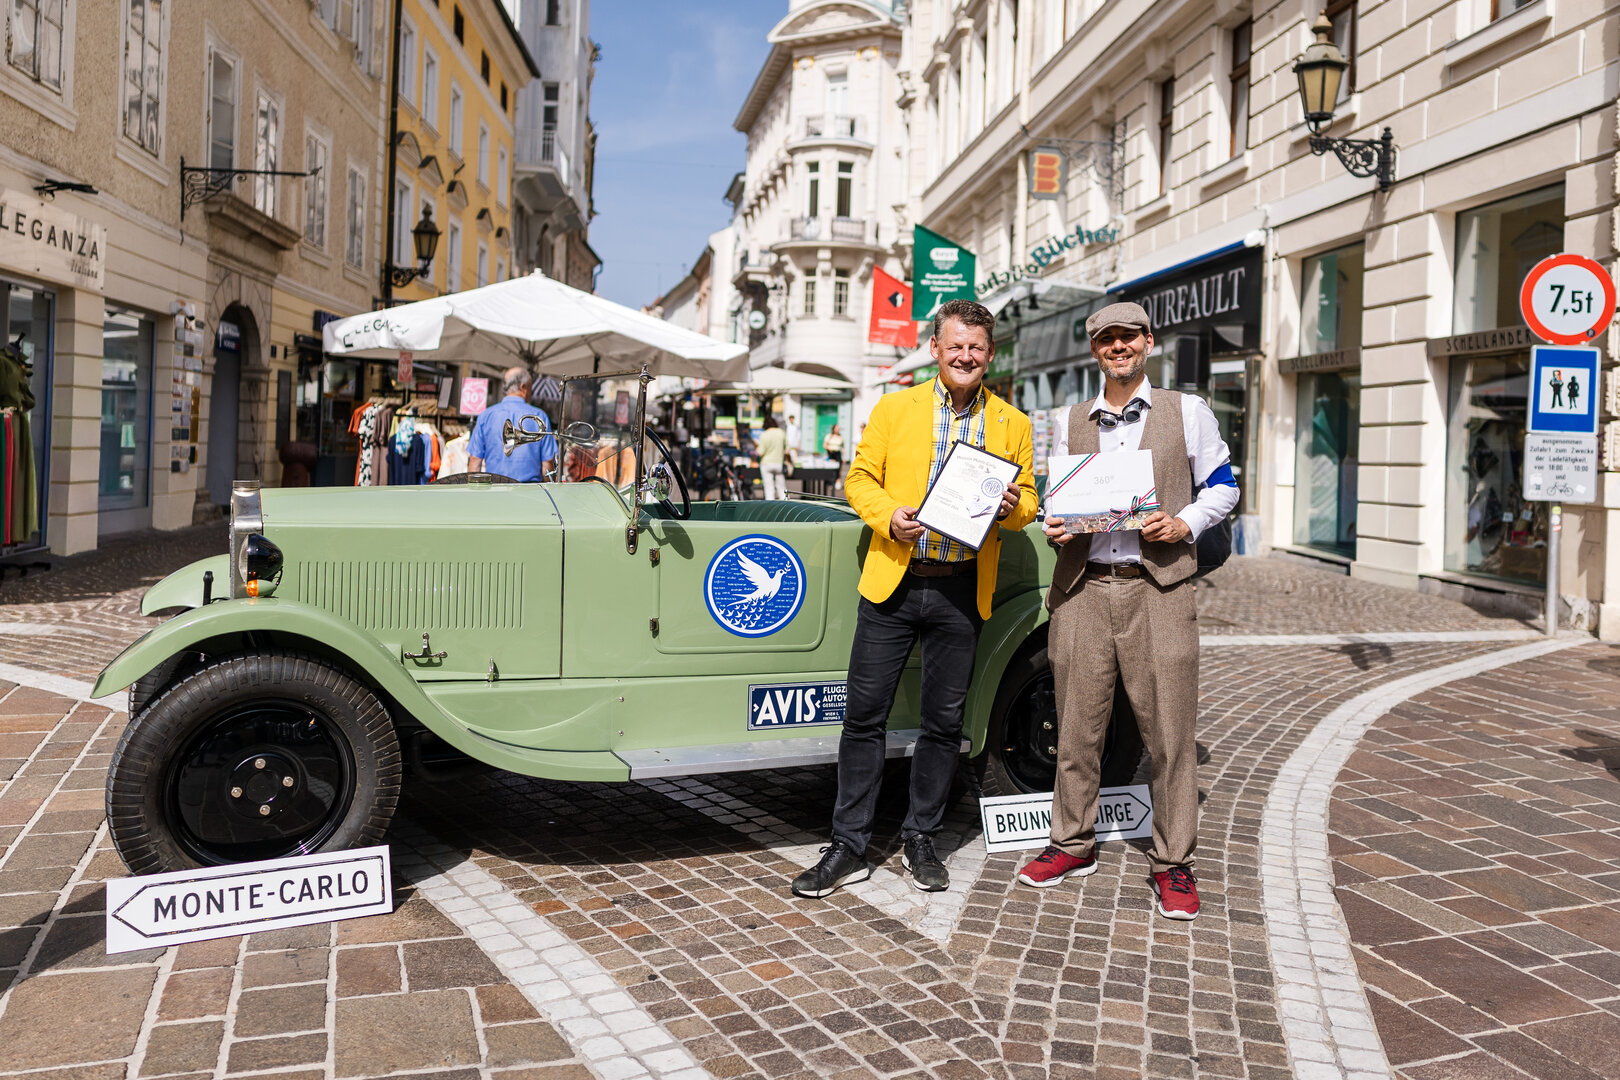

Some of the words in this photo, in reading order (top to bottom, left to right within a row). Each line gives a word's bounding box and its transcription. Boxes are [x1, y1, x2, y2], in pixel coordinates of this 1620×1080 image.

[1031, 224, 1121, 267] Bücher
[1138, 267, 1246, 330] OURFAULT
[1550, 284, 1593, 317] 7,5t
[1446, 328, 1532, 352] SCHELLANDER
[755, 688, 816, 725] AVIS
[153, 870, 369, 923] MONTE-CARLO
